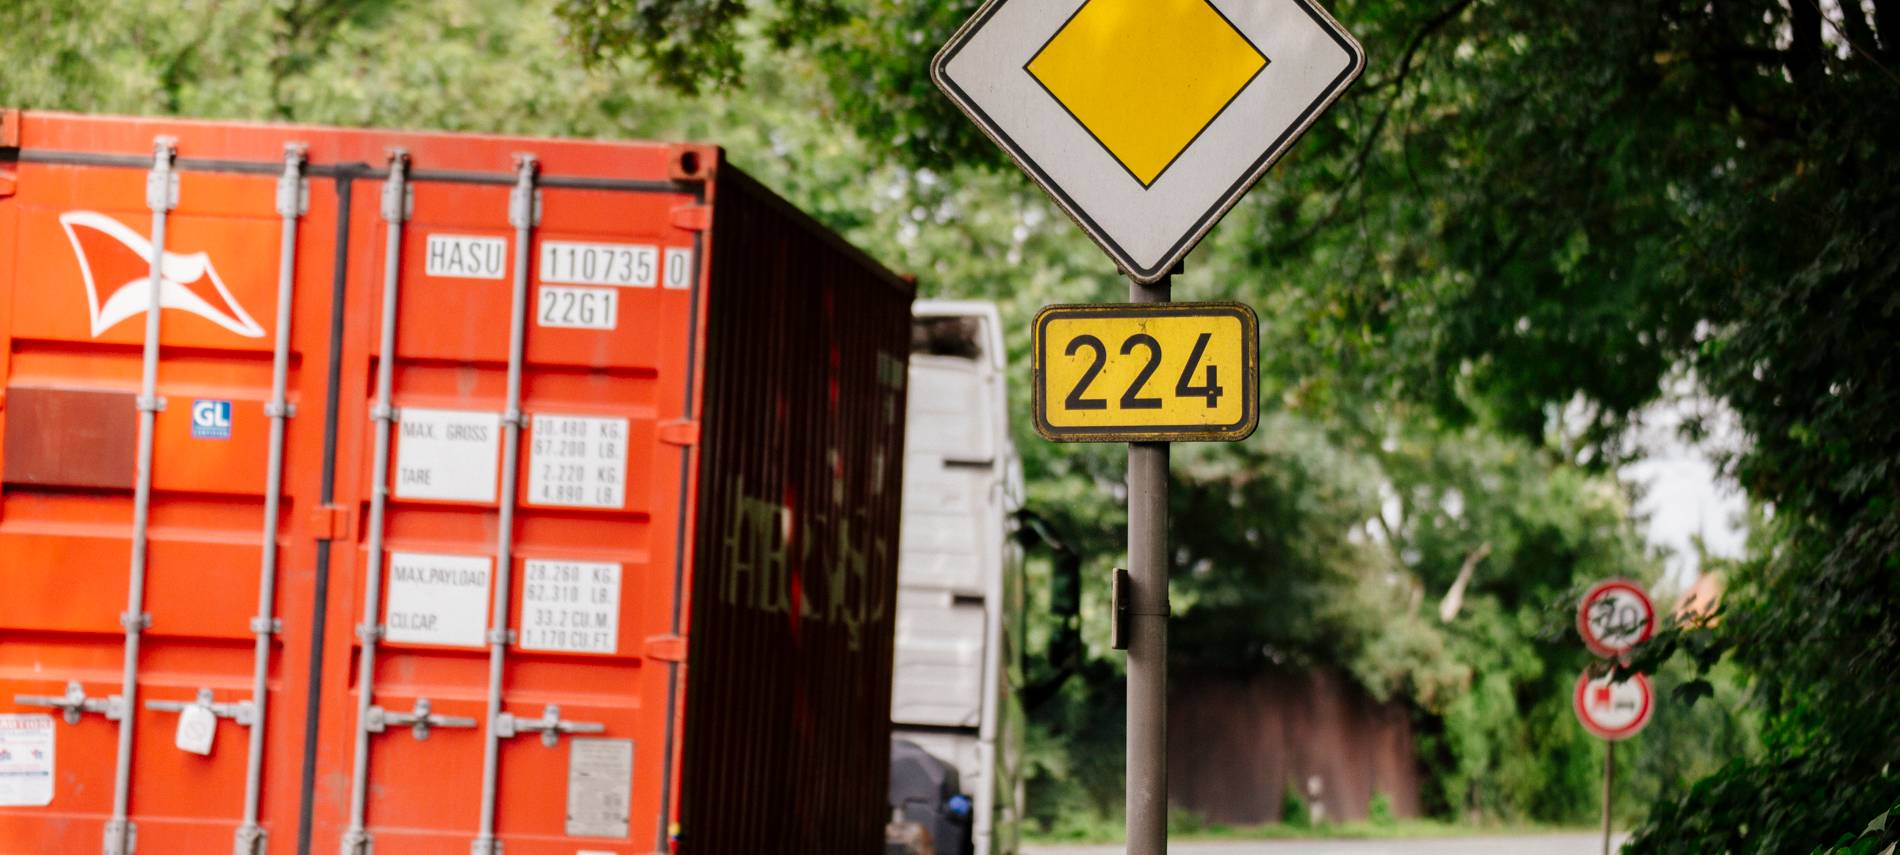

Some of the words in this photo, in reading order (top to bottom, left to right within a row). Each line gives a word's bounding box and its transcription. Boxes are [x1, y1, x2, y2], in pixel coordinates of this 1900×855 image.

[430, 240, 504, 275] HASU
[549, 246, 652, 283] 110735
[671, 253, 686, 286] 0
[543, 290, 611, 325] 22G1
[1065, 333, 1223, 410] 224
[194, 401, 229, 427] GL
[446, 423, 488, 442] GROSS
[600, 422, 621, 440] KG.
[599, 442, 619, 459] LB.
[401, 467, 431, 486] TARE
[543, 464, 584, 483] 2.220
[597, 466, 619, 484] KG.
[596, 487, 616, 504] LB.
[535, 609, 567, 627] 33.2
